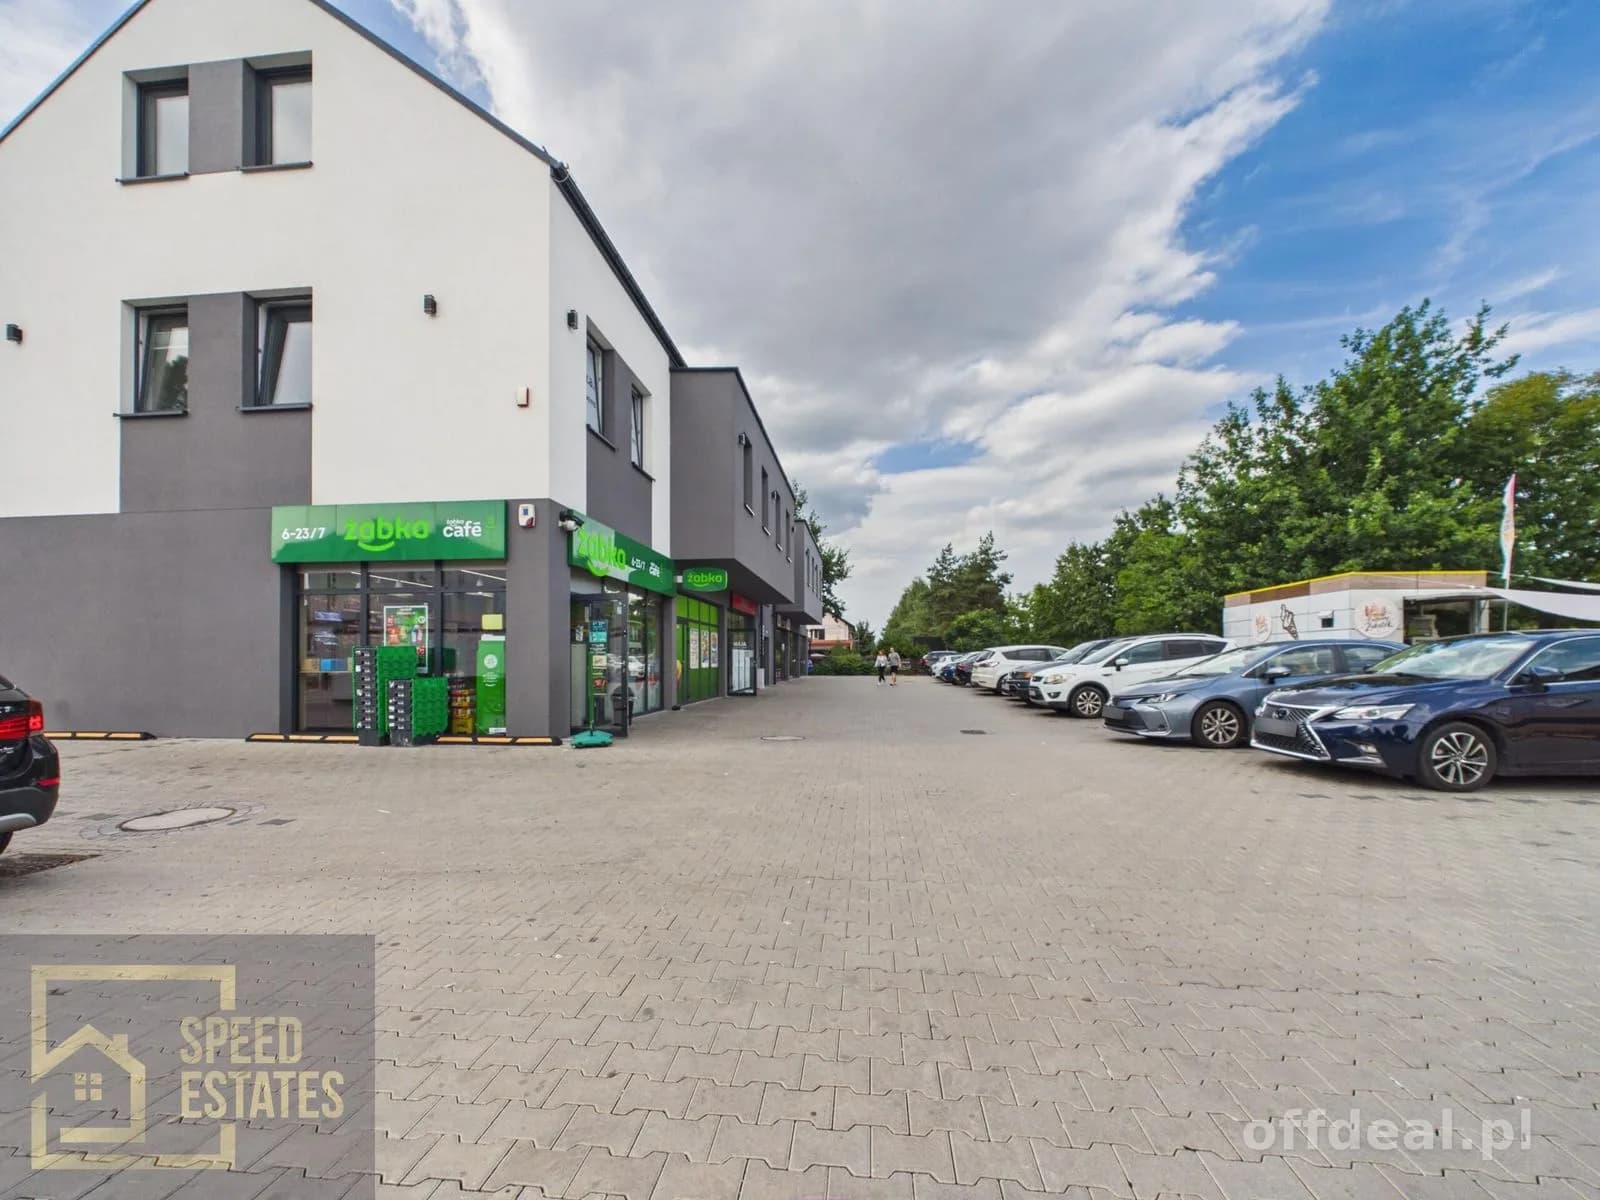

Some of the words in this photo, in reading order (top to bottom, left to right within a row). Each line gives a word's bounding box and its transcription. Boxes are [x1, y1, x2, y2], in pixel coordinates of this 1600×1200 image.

[281, 526, 326, 540] 6-23/7
[343, 515, 431, 541] żabka
[687, 572, 723, 584] żabka
